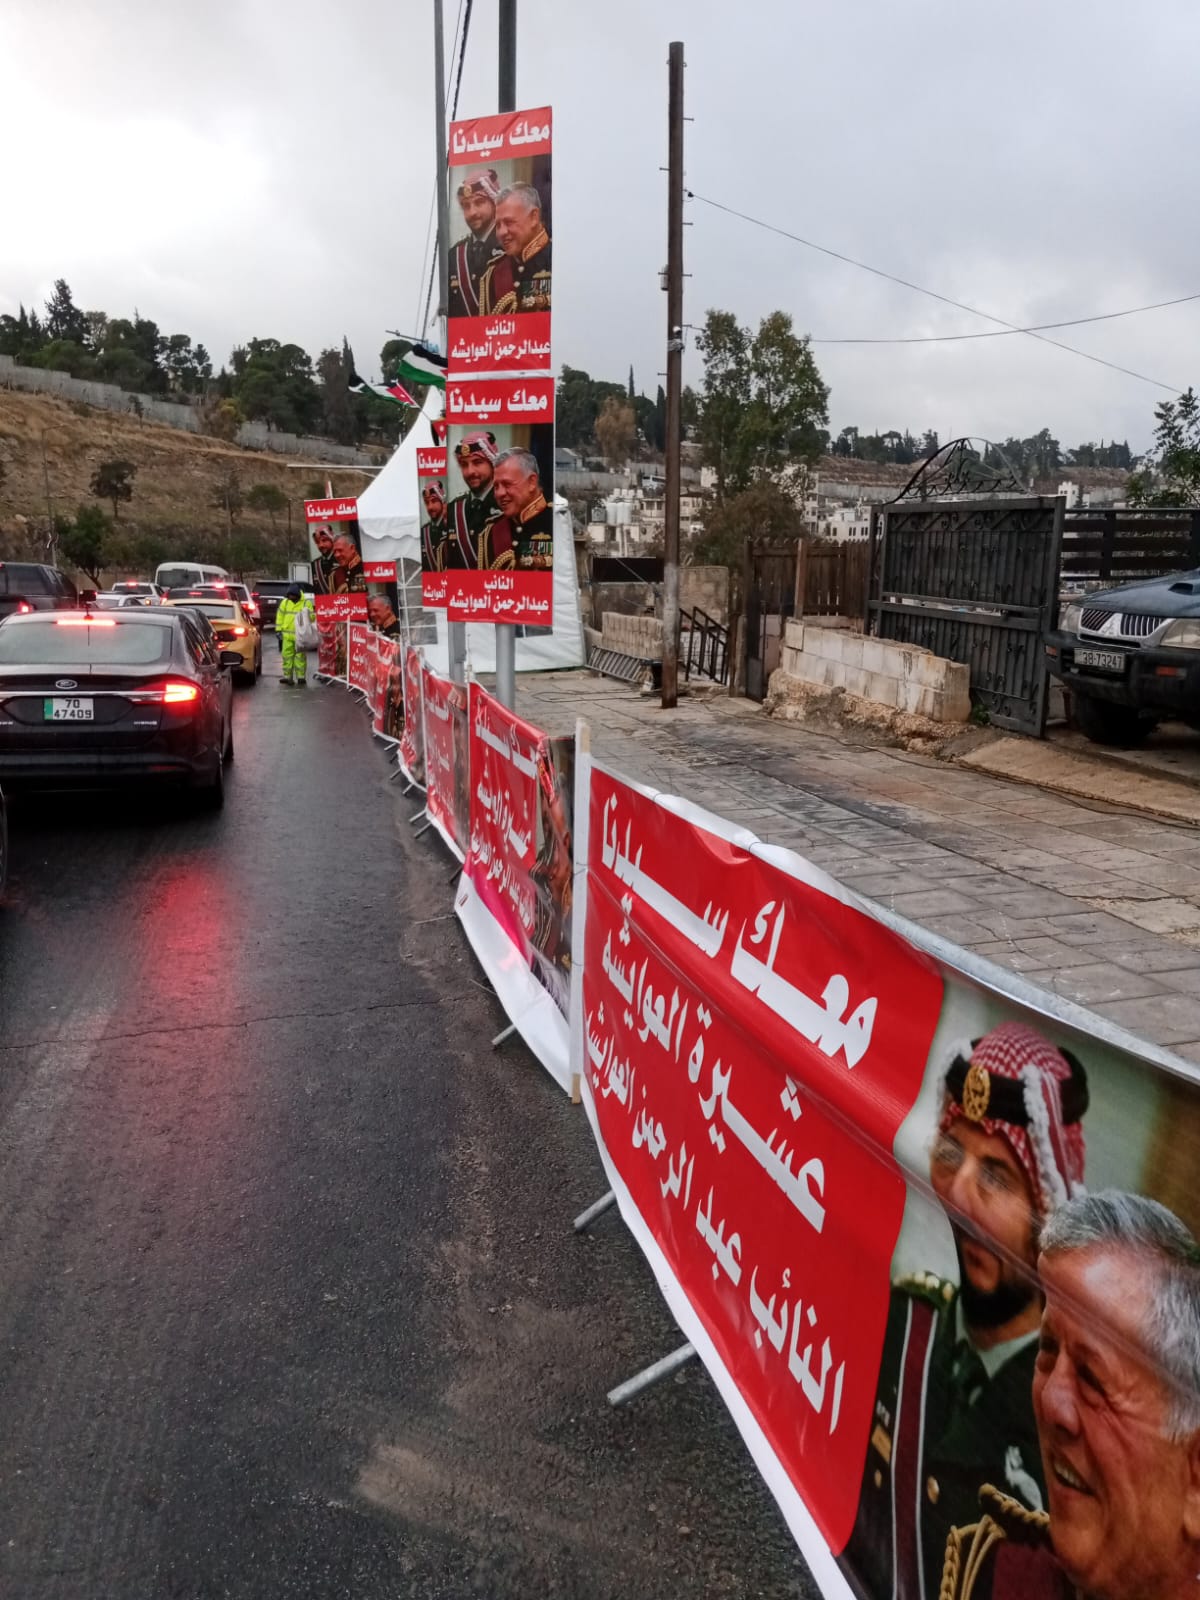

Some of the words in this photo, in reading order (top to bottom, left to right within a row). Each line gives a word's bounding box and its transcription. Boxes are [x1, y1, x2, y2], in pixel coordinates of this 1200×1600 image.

[453, 128, 504, 157] سيدنا
[509, 121, 550, 146] معك
[485, 319, 515, 340] النائب
[450, 388, 502, 419] سيدنا
[507, 389, 548, 412] معك
[418, 452, 446, 473] سيدنا
[307, 504, 334, 520] سيدنا
[336, 503, 357, 515] معك
[373, 565, 394, 577] معك
[483, 574, 514, 593] النائب
[1083, 652, 1122, 668] 38-73247
[54, 709, 92, 719] 47409
[65, 699, 80, 708] 70
[602, 792, 729, 958] سيدنا
[731, 900, 878, 1069] معك
[688, 1003, 826, 1234] عشيرة
[749, 1265, 845, 1435] النائب
